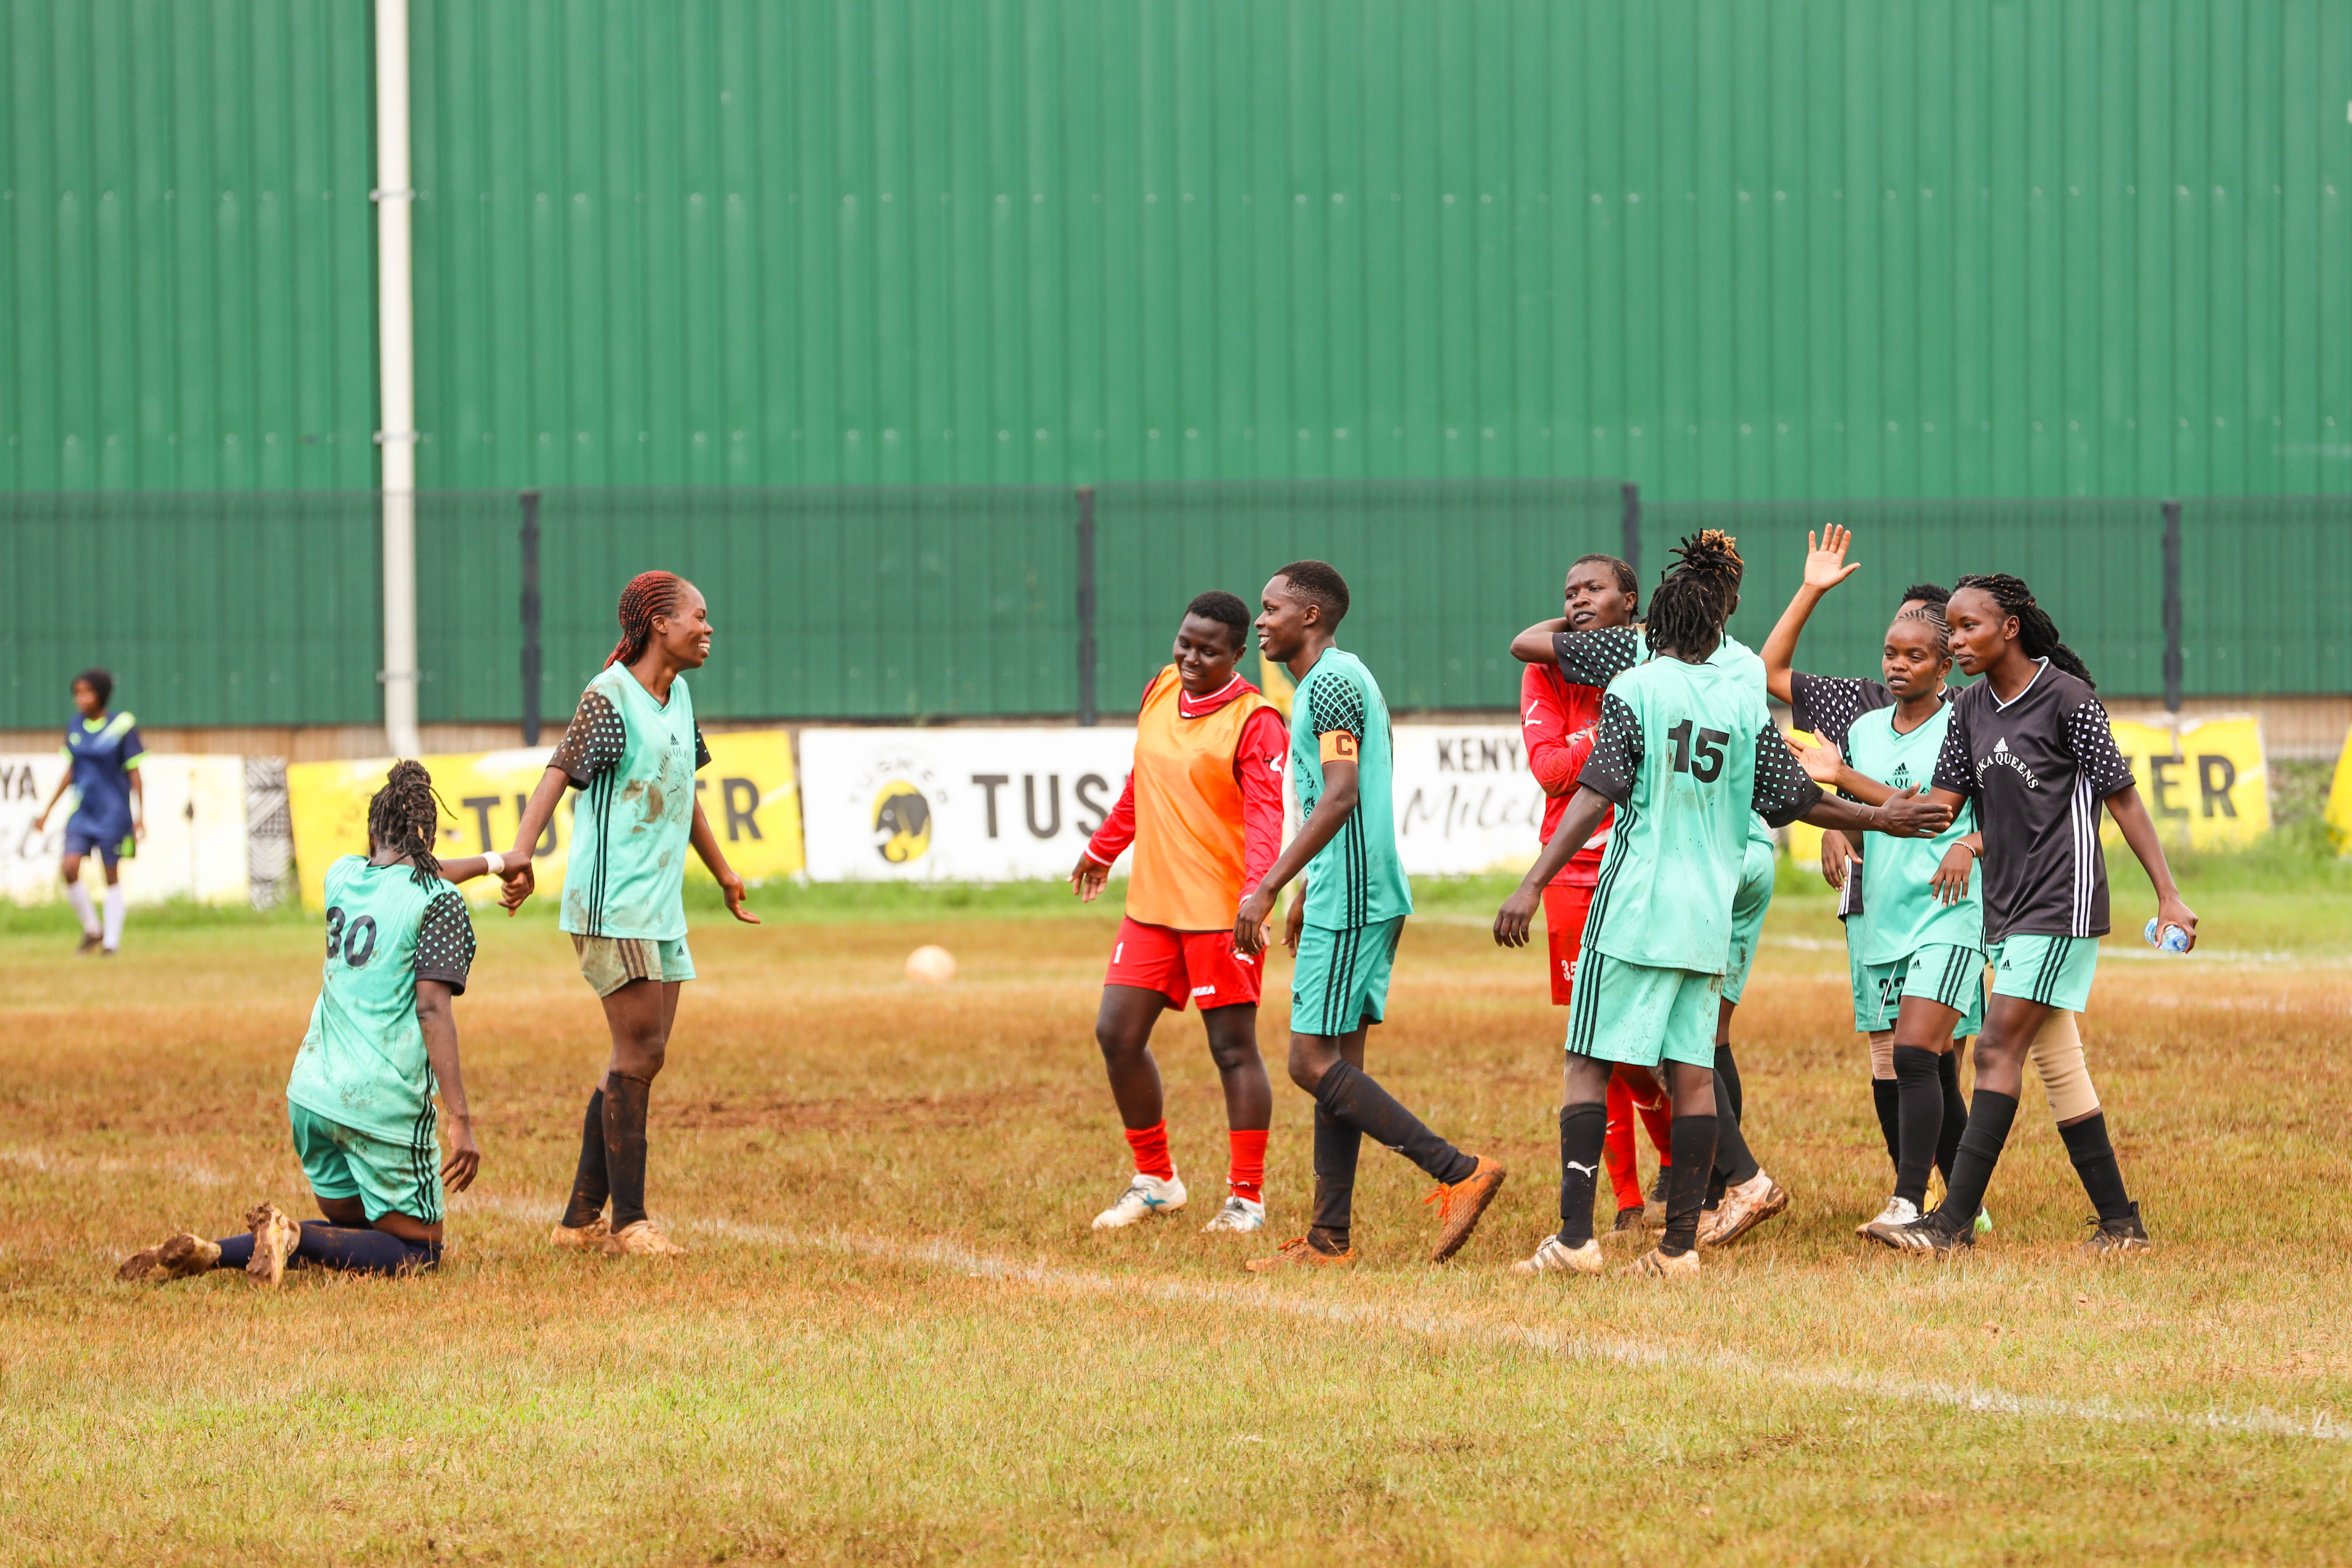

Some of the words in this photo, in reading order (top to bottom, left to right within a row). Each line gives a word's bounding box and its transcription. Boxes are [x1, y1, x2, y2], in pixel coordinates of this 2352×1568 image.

[1336, 734, 1353, 756] C
[1437, 737, 1531, 772] KENY
[1668, 719, 1730, 783] 15
[1995, 752, 2039, 789] QUEENS
[972, 774, 1130, 839] TUS
[326, 906, 377, 967] 30
[1114, 942, 1124, 964] 1
